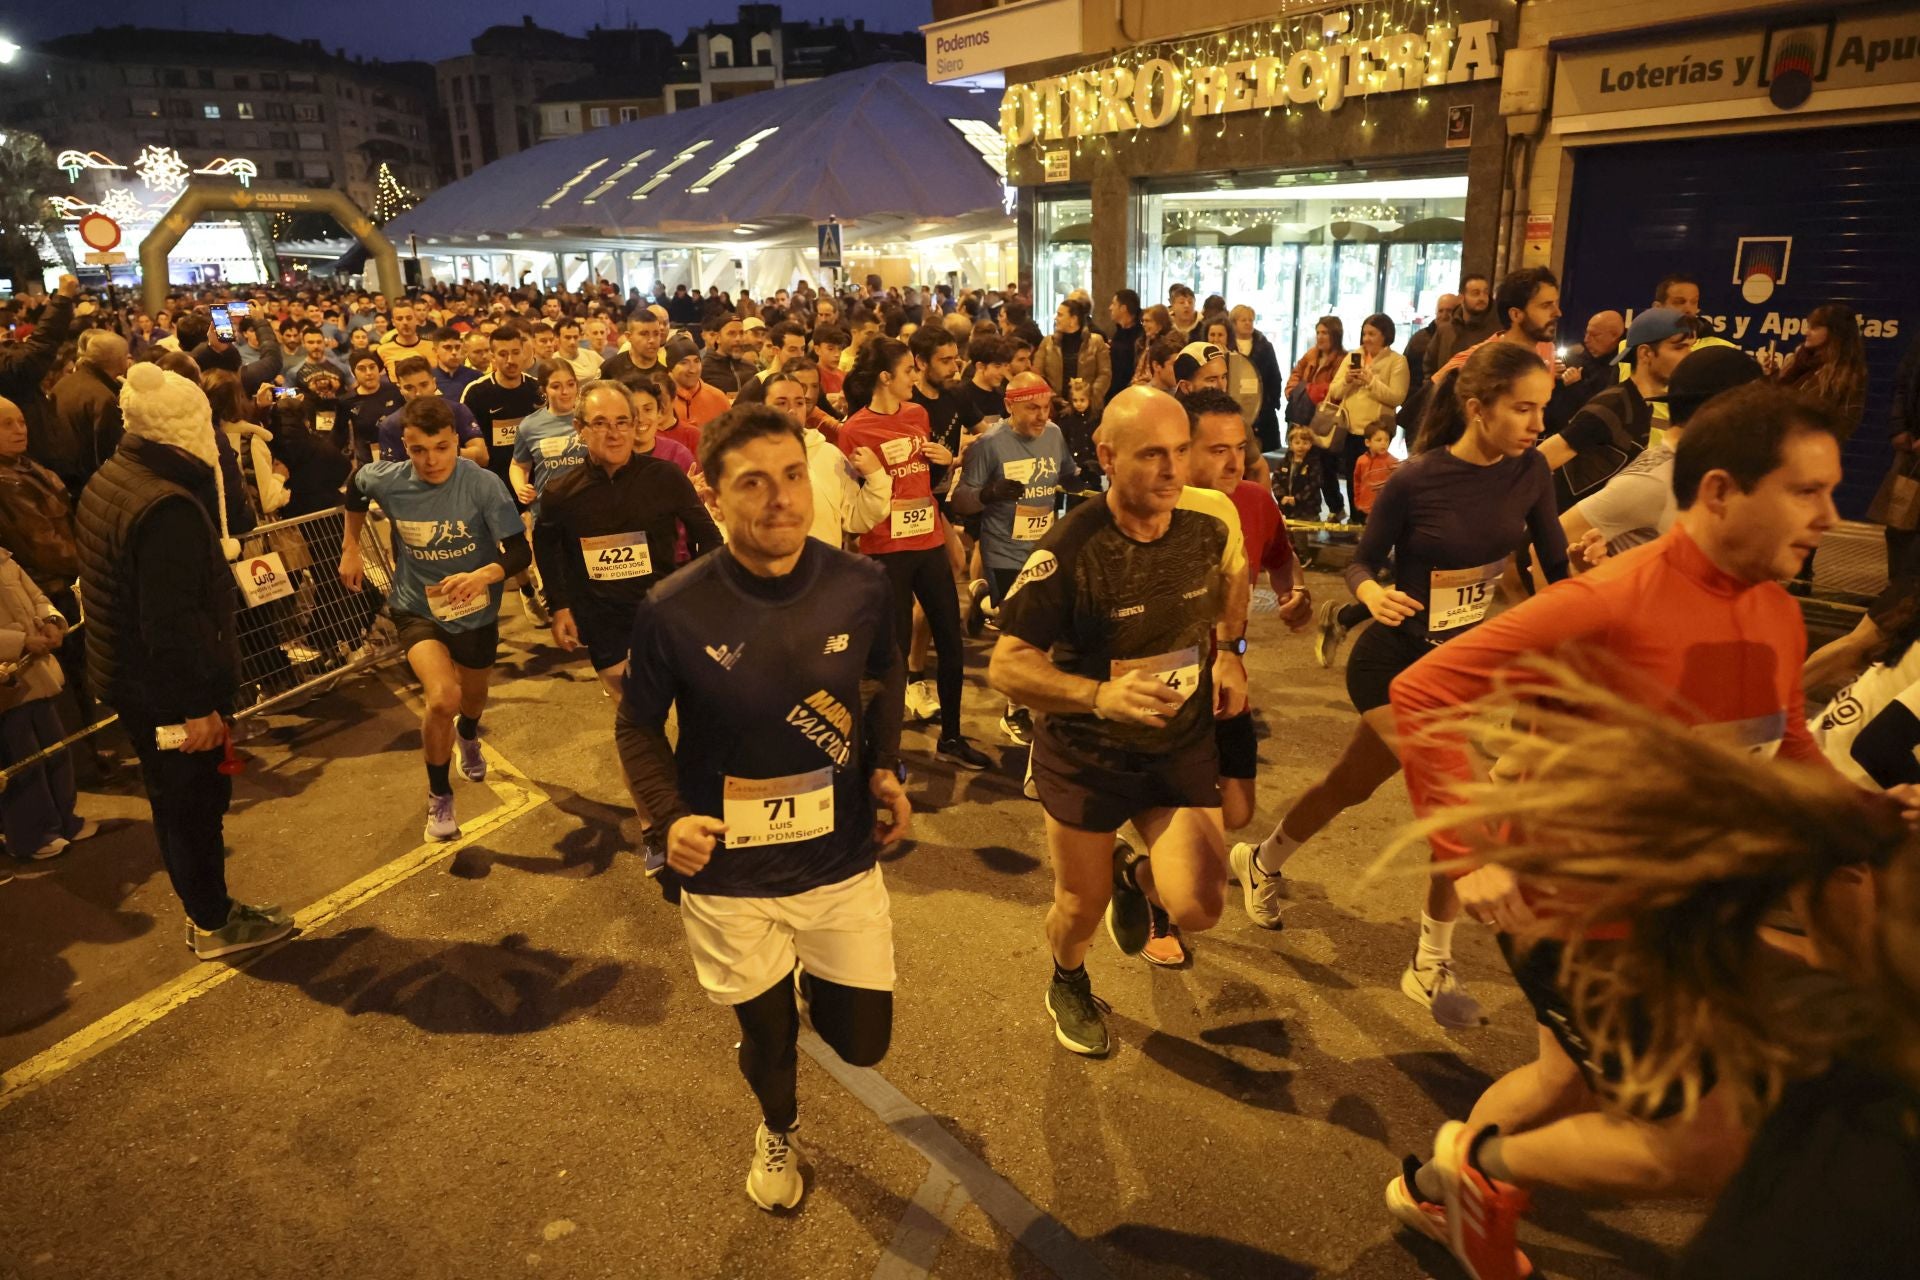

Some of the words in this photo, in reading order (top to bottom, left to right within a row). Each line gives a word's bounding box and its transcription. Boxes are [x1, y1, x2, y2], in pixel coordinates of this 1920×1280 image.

[936, 30, 990, 54] Podemos
[936, 58, 964, 74] Siero
[1600, 55, 1724, 94] Loterías
[1731, 55, 1755, 88] y
[1836, 35, 1920, 73] Apu
[1000, 58, 1183, 147] OTERO
[1190, 18, 1499, 117] RELOJERIA
[1732, 315, 1752, 339] y
[1759, 311, 1899, 341] Aputas
[902, 508, 927, 524] 592
[1027, 515, 1048, 529] 715
[404, 542, 477, 561] PDMSiero
[598, 546, 635, 565] 422
[591, 563, 628, 572] FRANCISCO
[610, 569, 646, 578] PDMSiero
[1456, 582, 1486, 607] 113
[763, 797, 796, 821] 71
[766, 826, 824, 842] PDMSiero
[769, 821, 793, 831] LUIS
